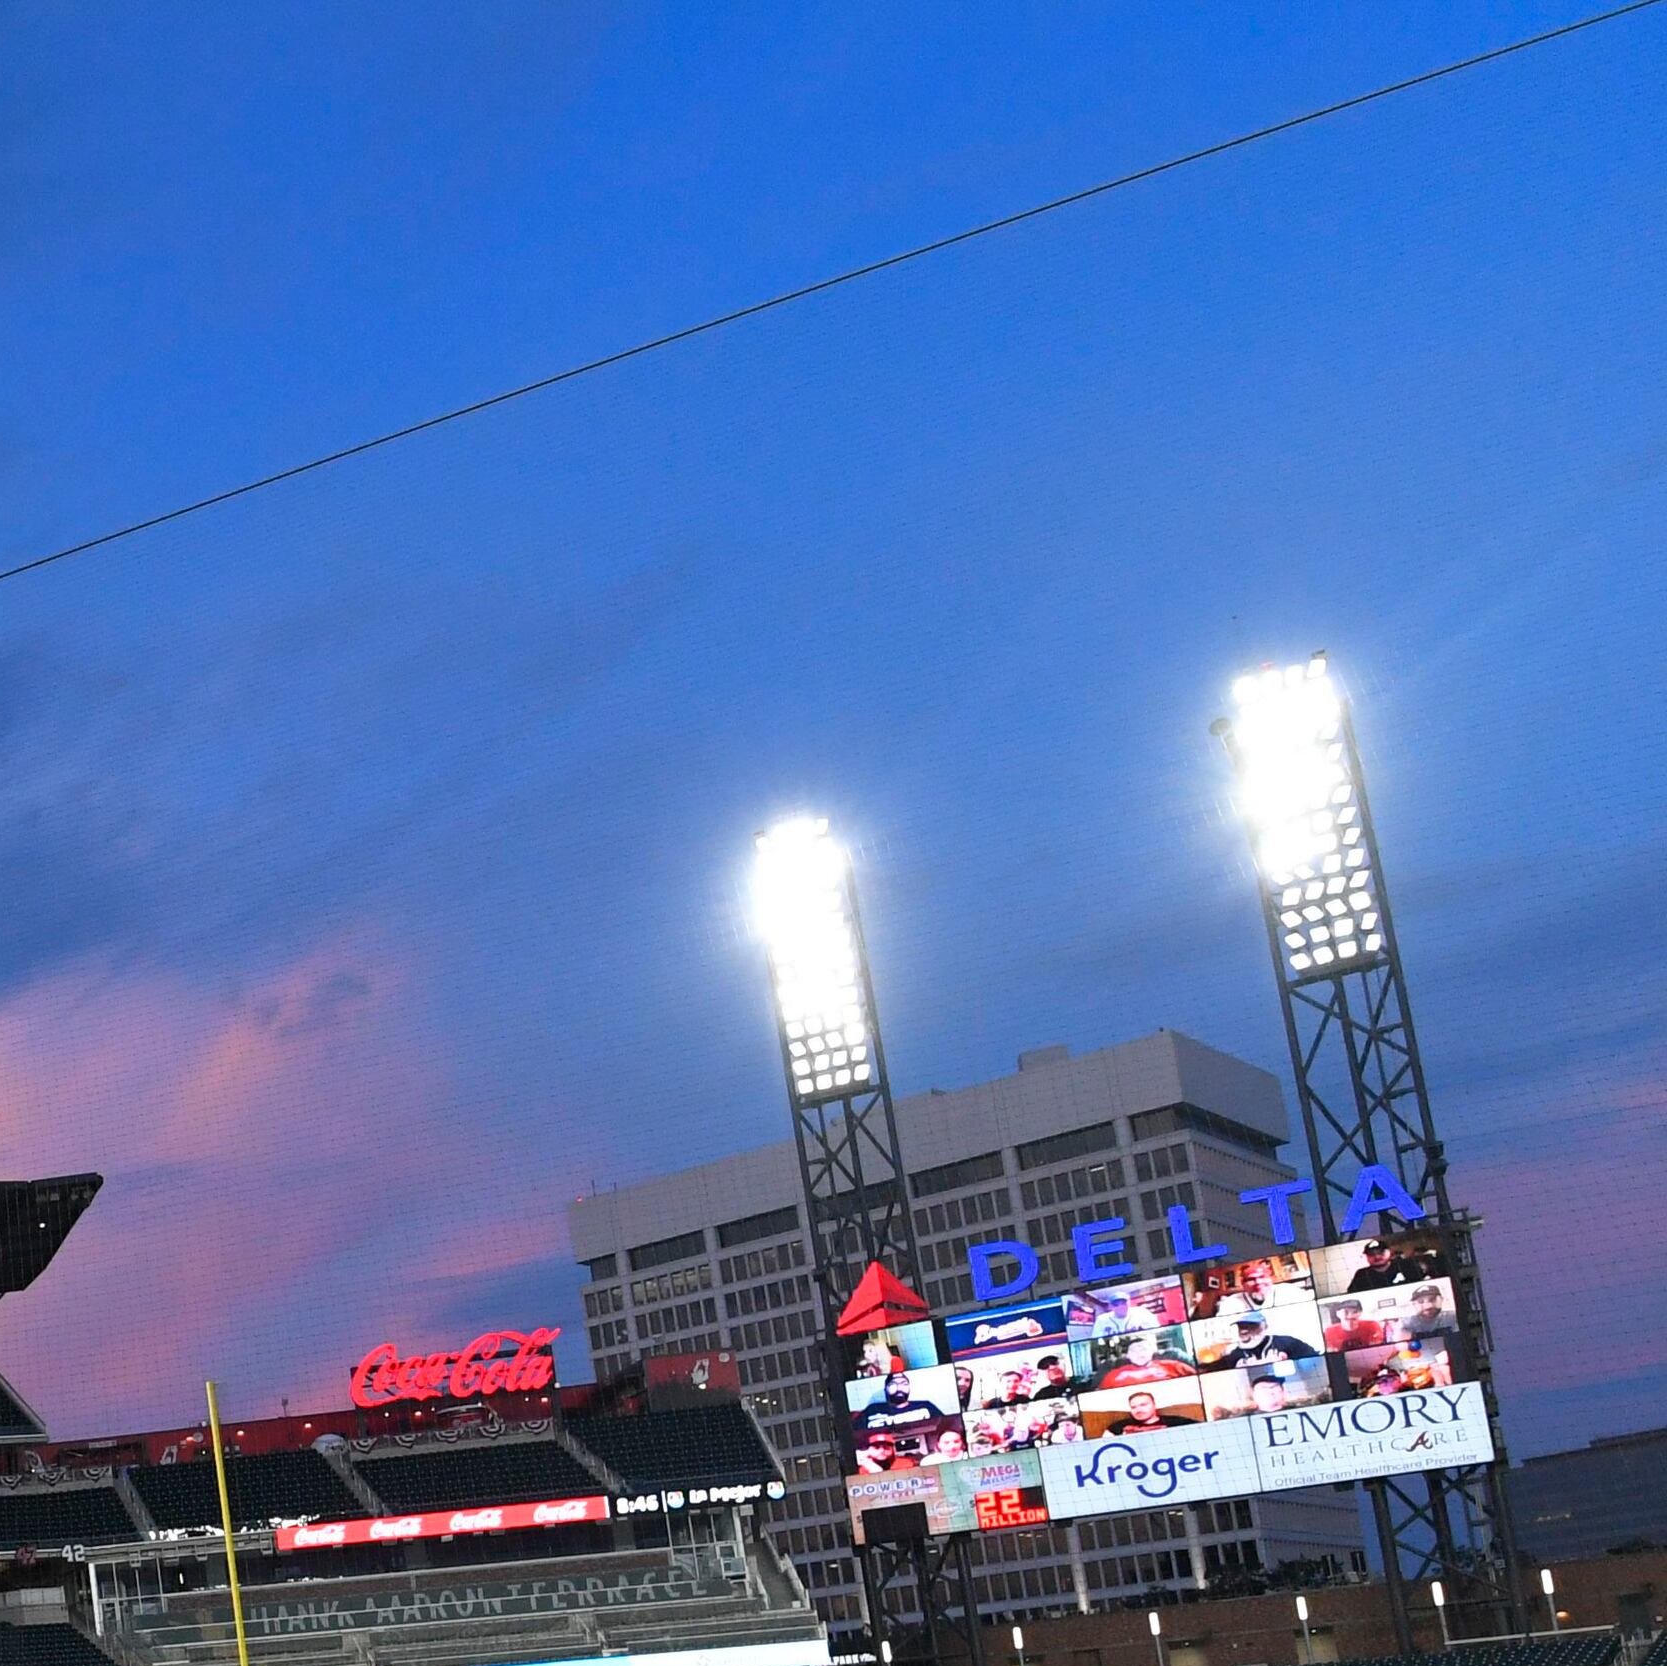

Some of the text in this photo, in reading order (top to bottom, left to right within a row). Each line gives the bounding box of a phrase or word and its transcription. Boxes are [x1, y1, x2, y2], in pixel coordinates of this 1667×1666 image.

[969, 1164, 1426, 1301] DELTA
[1261, 1387, 1468, 1448] EMORY
[1270, 1429, 1468, 1469] HEALTHCARE
[1075, 1443, 1220, 1497] Kroger
[1275, 1453, 1478, 1487] Official Team Healthcare Provider
[978, 1488, 1021, 1517] 22
[981, 1508, 1048, 1529] MILLION
[62, 1544, 87, 1563] 42
[251, 1570, 708, 1633] HANK AARON TERRACE
